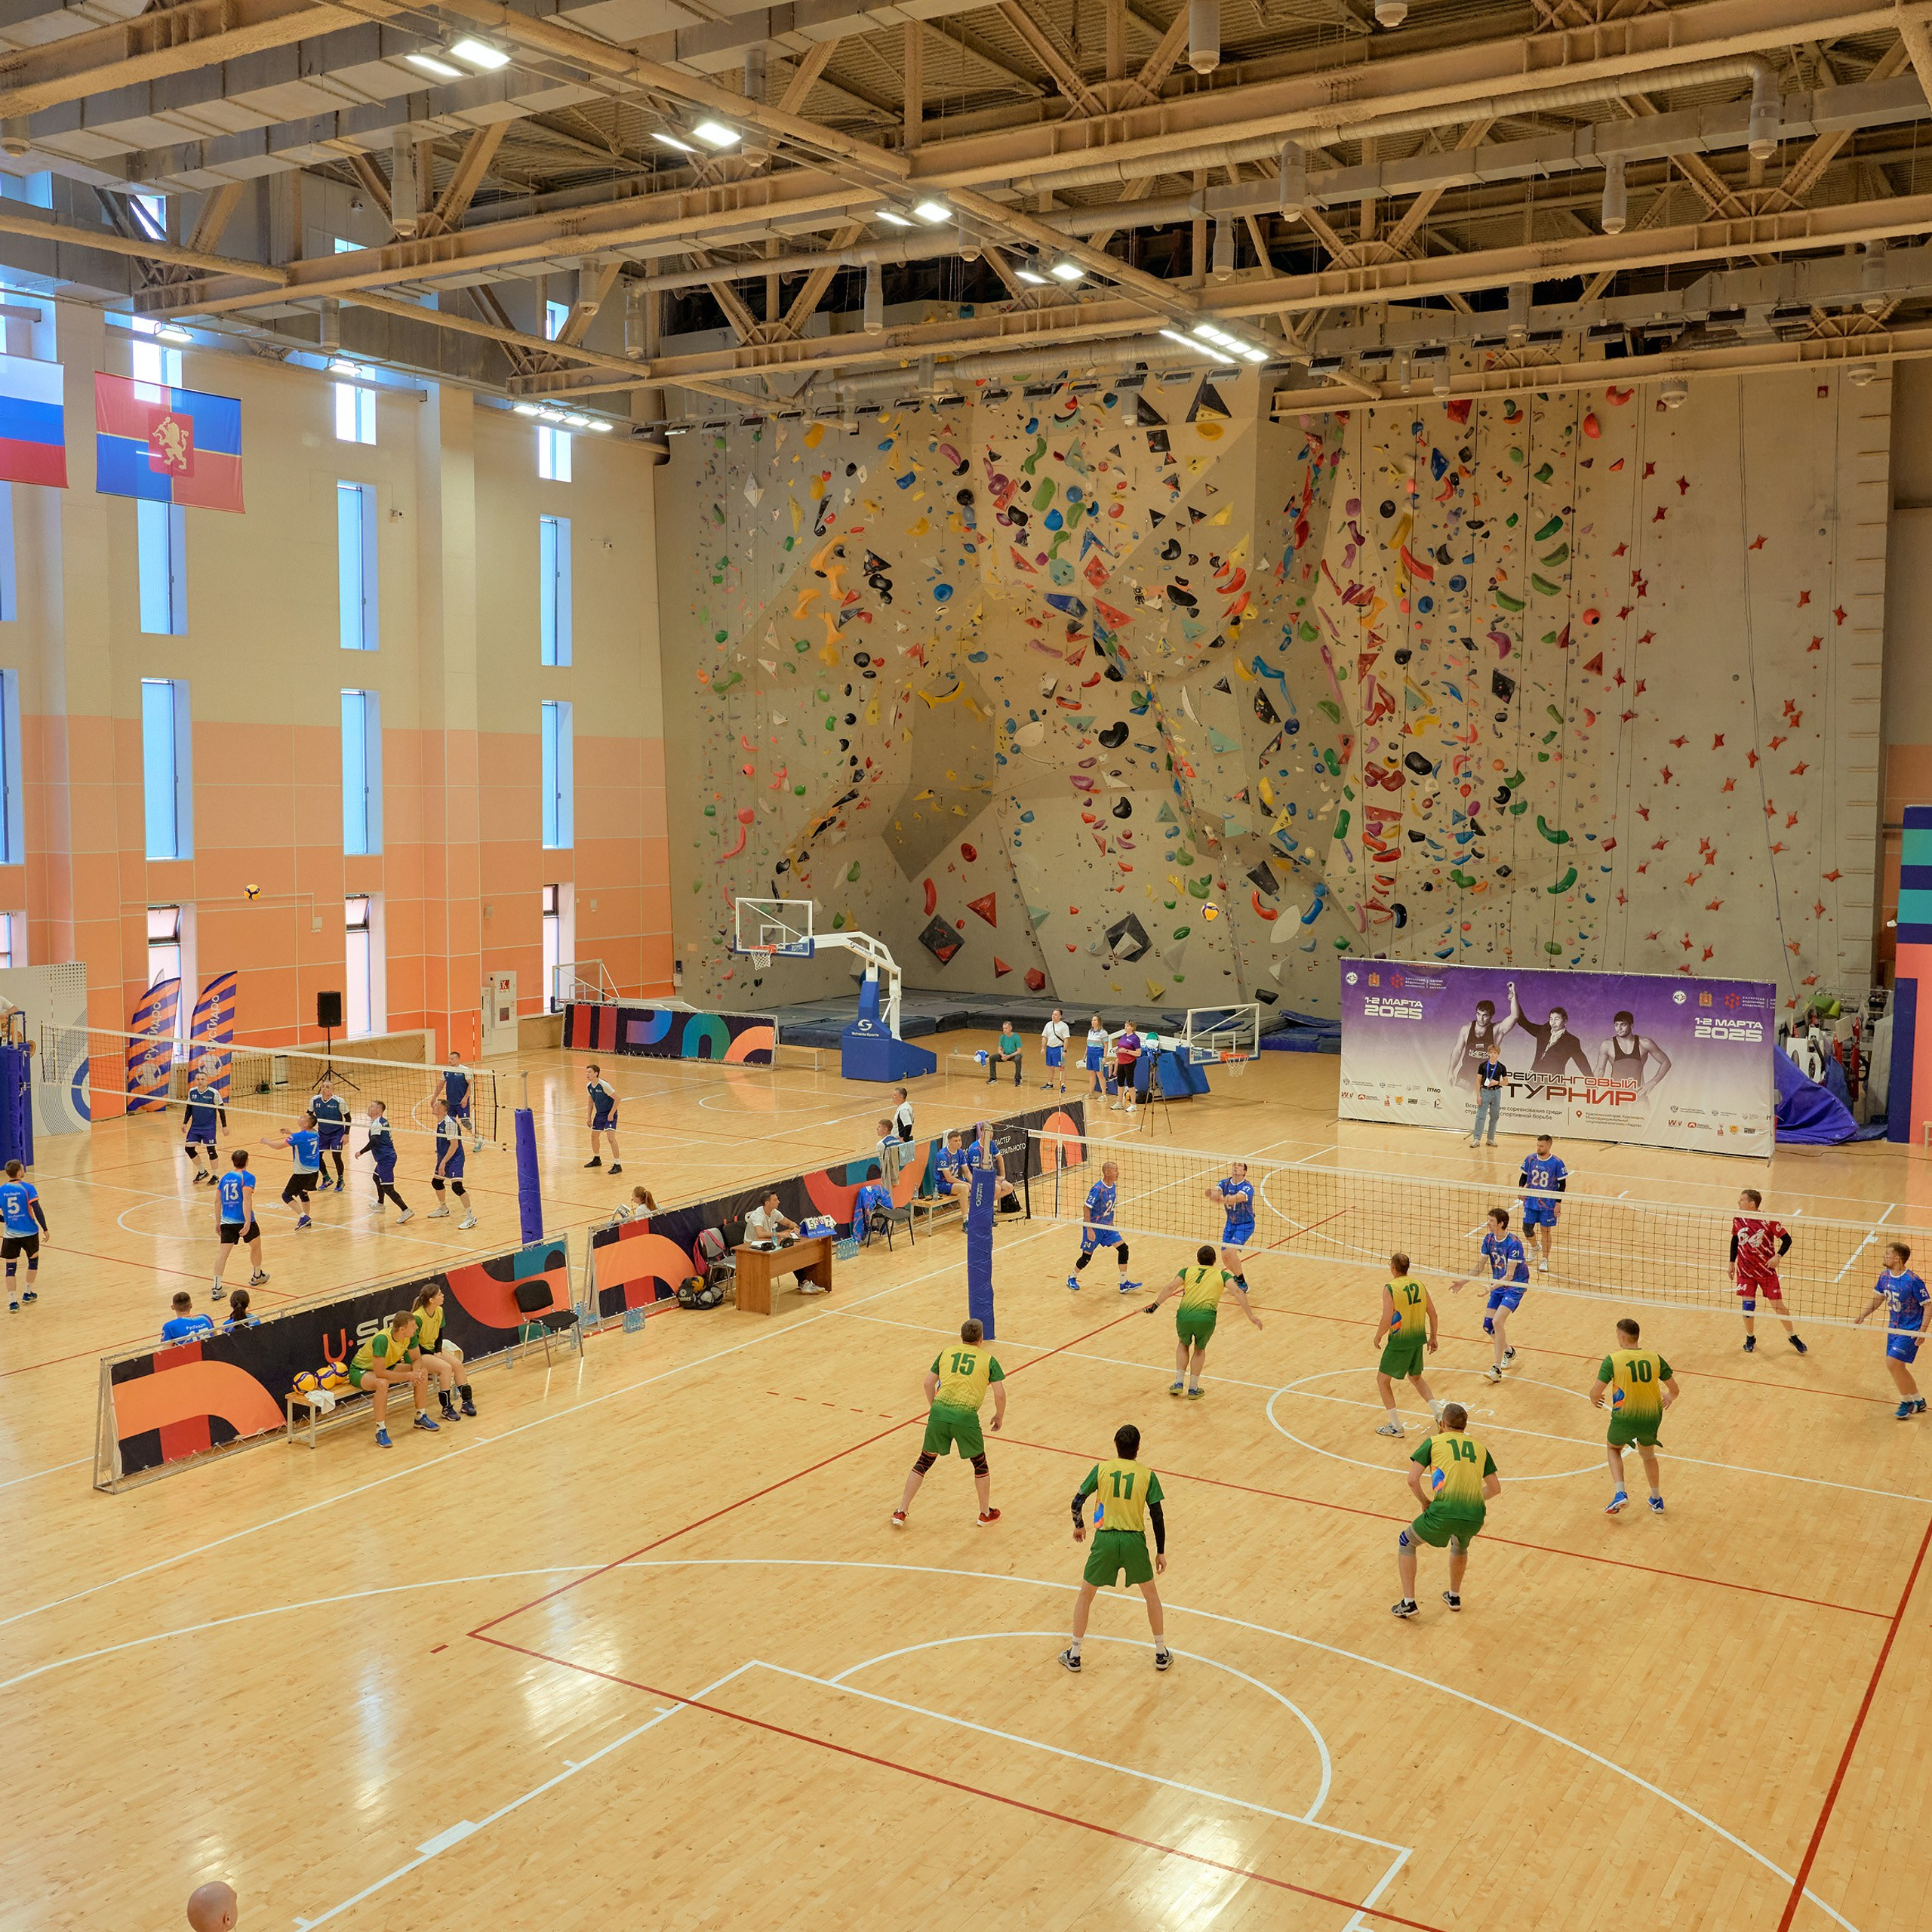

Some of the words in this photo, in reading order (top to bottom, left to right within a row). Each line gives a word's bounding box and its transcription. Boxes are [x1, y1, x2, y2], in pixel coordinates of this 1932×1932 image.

[1364, 996, 1380, 1004] 1-2
[1382, 998, 1423, 1008] МАРТА
[1364, 1004, 1423, 1020] 2025
[1694, 1017, 1712, 1026] 1-2
[1715, 1019, 1764, 1029] МАРТА
[1694, 1026, 1763, 1042] 2025
[1506, 1070, 1638, 1089] РЕЙТИНГОВЫЙ
[1507, 1083, 1637, 1106] ТУРНИР
[309, 1140, 318, 1155] 7
[994, 1135, 1011, 1146] ЛАСТЕР
[1000, 1143, 1026, 1155] ЕРАЛЬНОГО
[1531, 1169, 1549, 1188] 28
[223, 1183, 239, 1201] 13
[7, 1196, 20, 1214] 5
[809, 1220, 815, 1228] 5
[825, 1217, 830, 1226] 7
[1737, 1226, 1765, 1247] 64
[1491, 1252, 1507, 1272] 21
[1195, 1268, 1207, 1284] 7
[1403, 1283, 1422, 1306] 12
[1737, 1283, 1748, 1291] 64
[1919, 1288, 1928, 1297] 25
[1884, 1289, 1902, 1312] 25
[951, 1352, 977, 1376] 15
[1626, 1359, 1652, 1383] 10
[1446, 1438, 1477, 1463] 14
[1109, 1470, 1135, 1500] 11
